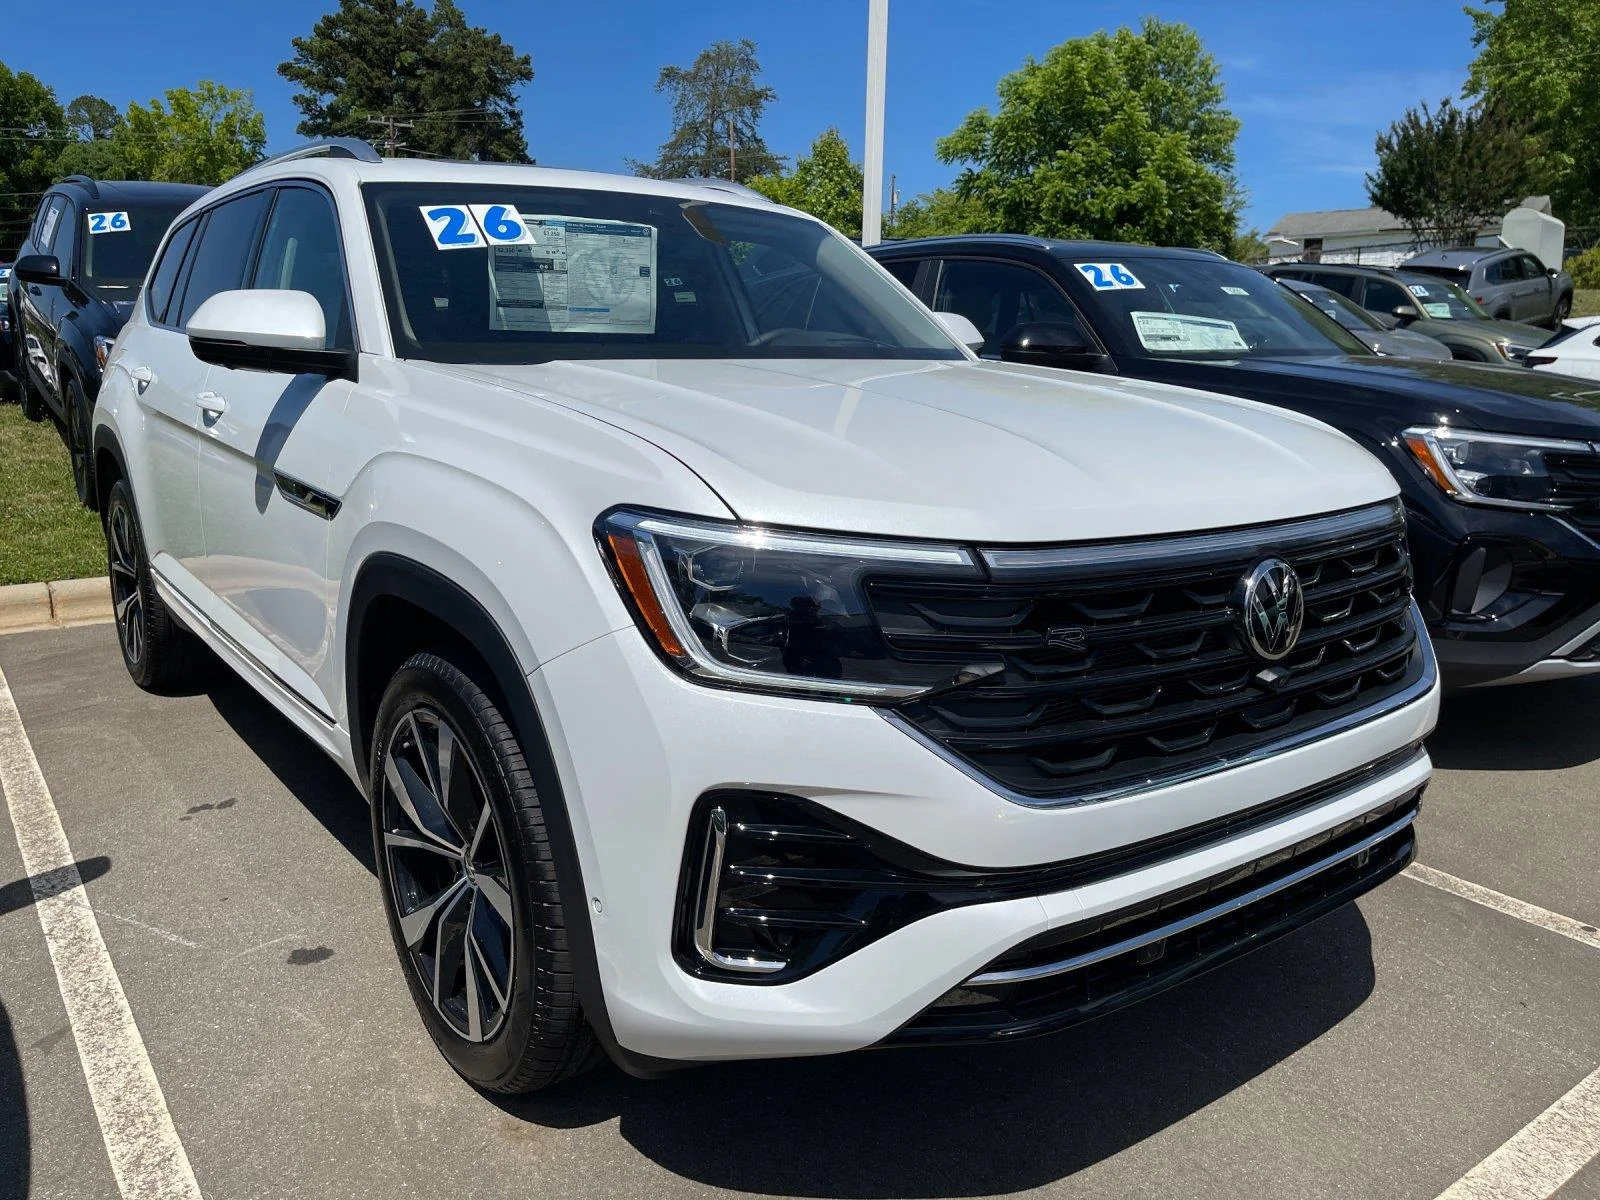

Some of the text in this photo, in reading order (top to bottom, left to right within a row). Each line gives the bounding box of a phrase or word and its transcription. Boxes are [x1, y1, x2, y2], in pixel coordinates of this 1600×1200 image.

[90, 212, 127, 231] 26
[427, 205, 526, 245] 26
[1080, 264, 1135, 287] 26
